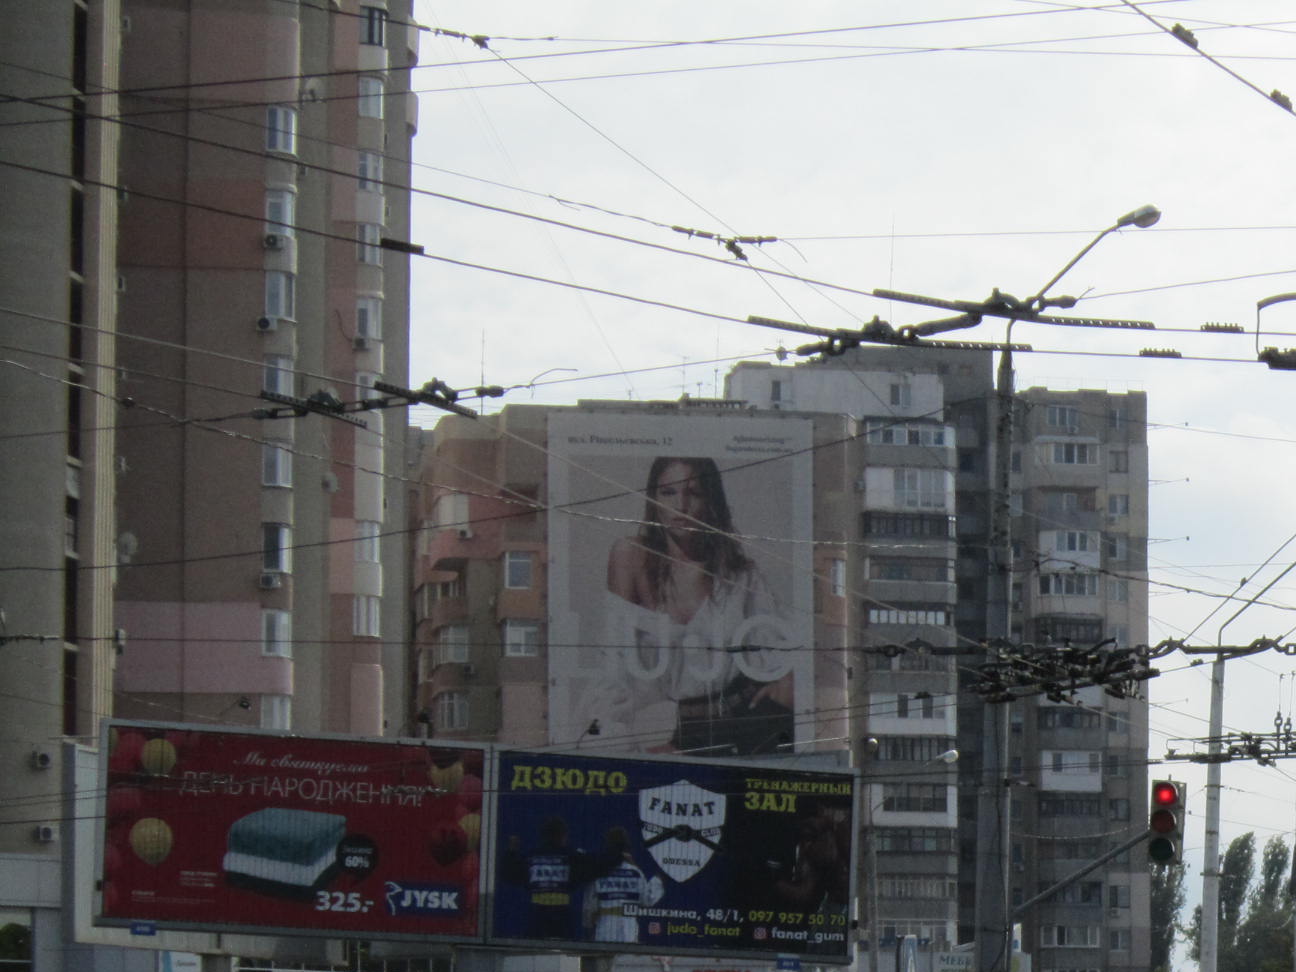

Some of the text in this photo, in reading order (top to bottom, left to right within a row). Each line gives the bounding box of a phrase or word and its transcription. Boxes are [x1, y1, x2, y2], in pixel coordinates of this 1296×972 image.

[511, 766, 629, 797] ДЗЮДО
[649, 796, 716, 817] FANAT
[744, 792, 798, 814] ЗАЛ
[344, 856, 369, 870] 60%
[662, 856, 702, 868] ODESSA
[401, 888, 459, 911] JYSK
[623, 904, 847, 926] Шишкина, 48/1, 097 957 50 70
[667, 922, 742, 938] judo_fanat
[771, 927, 845, 944] fanat_gum
